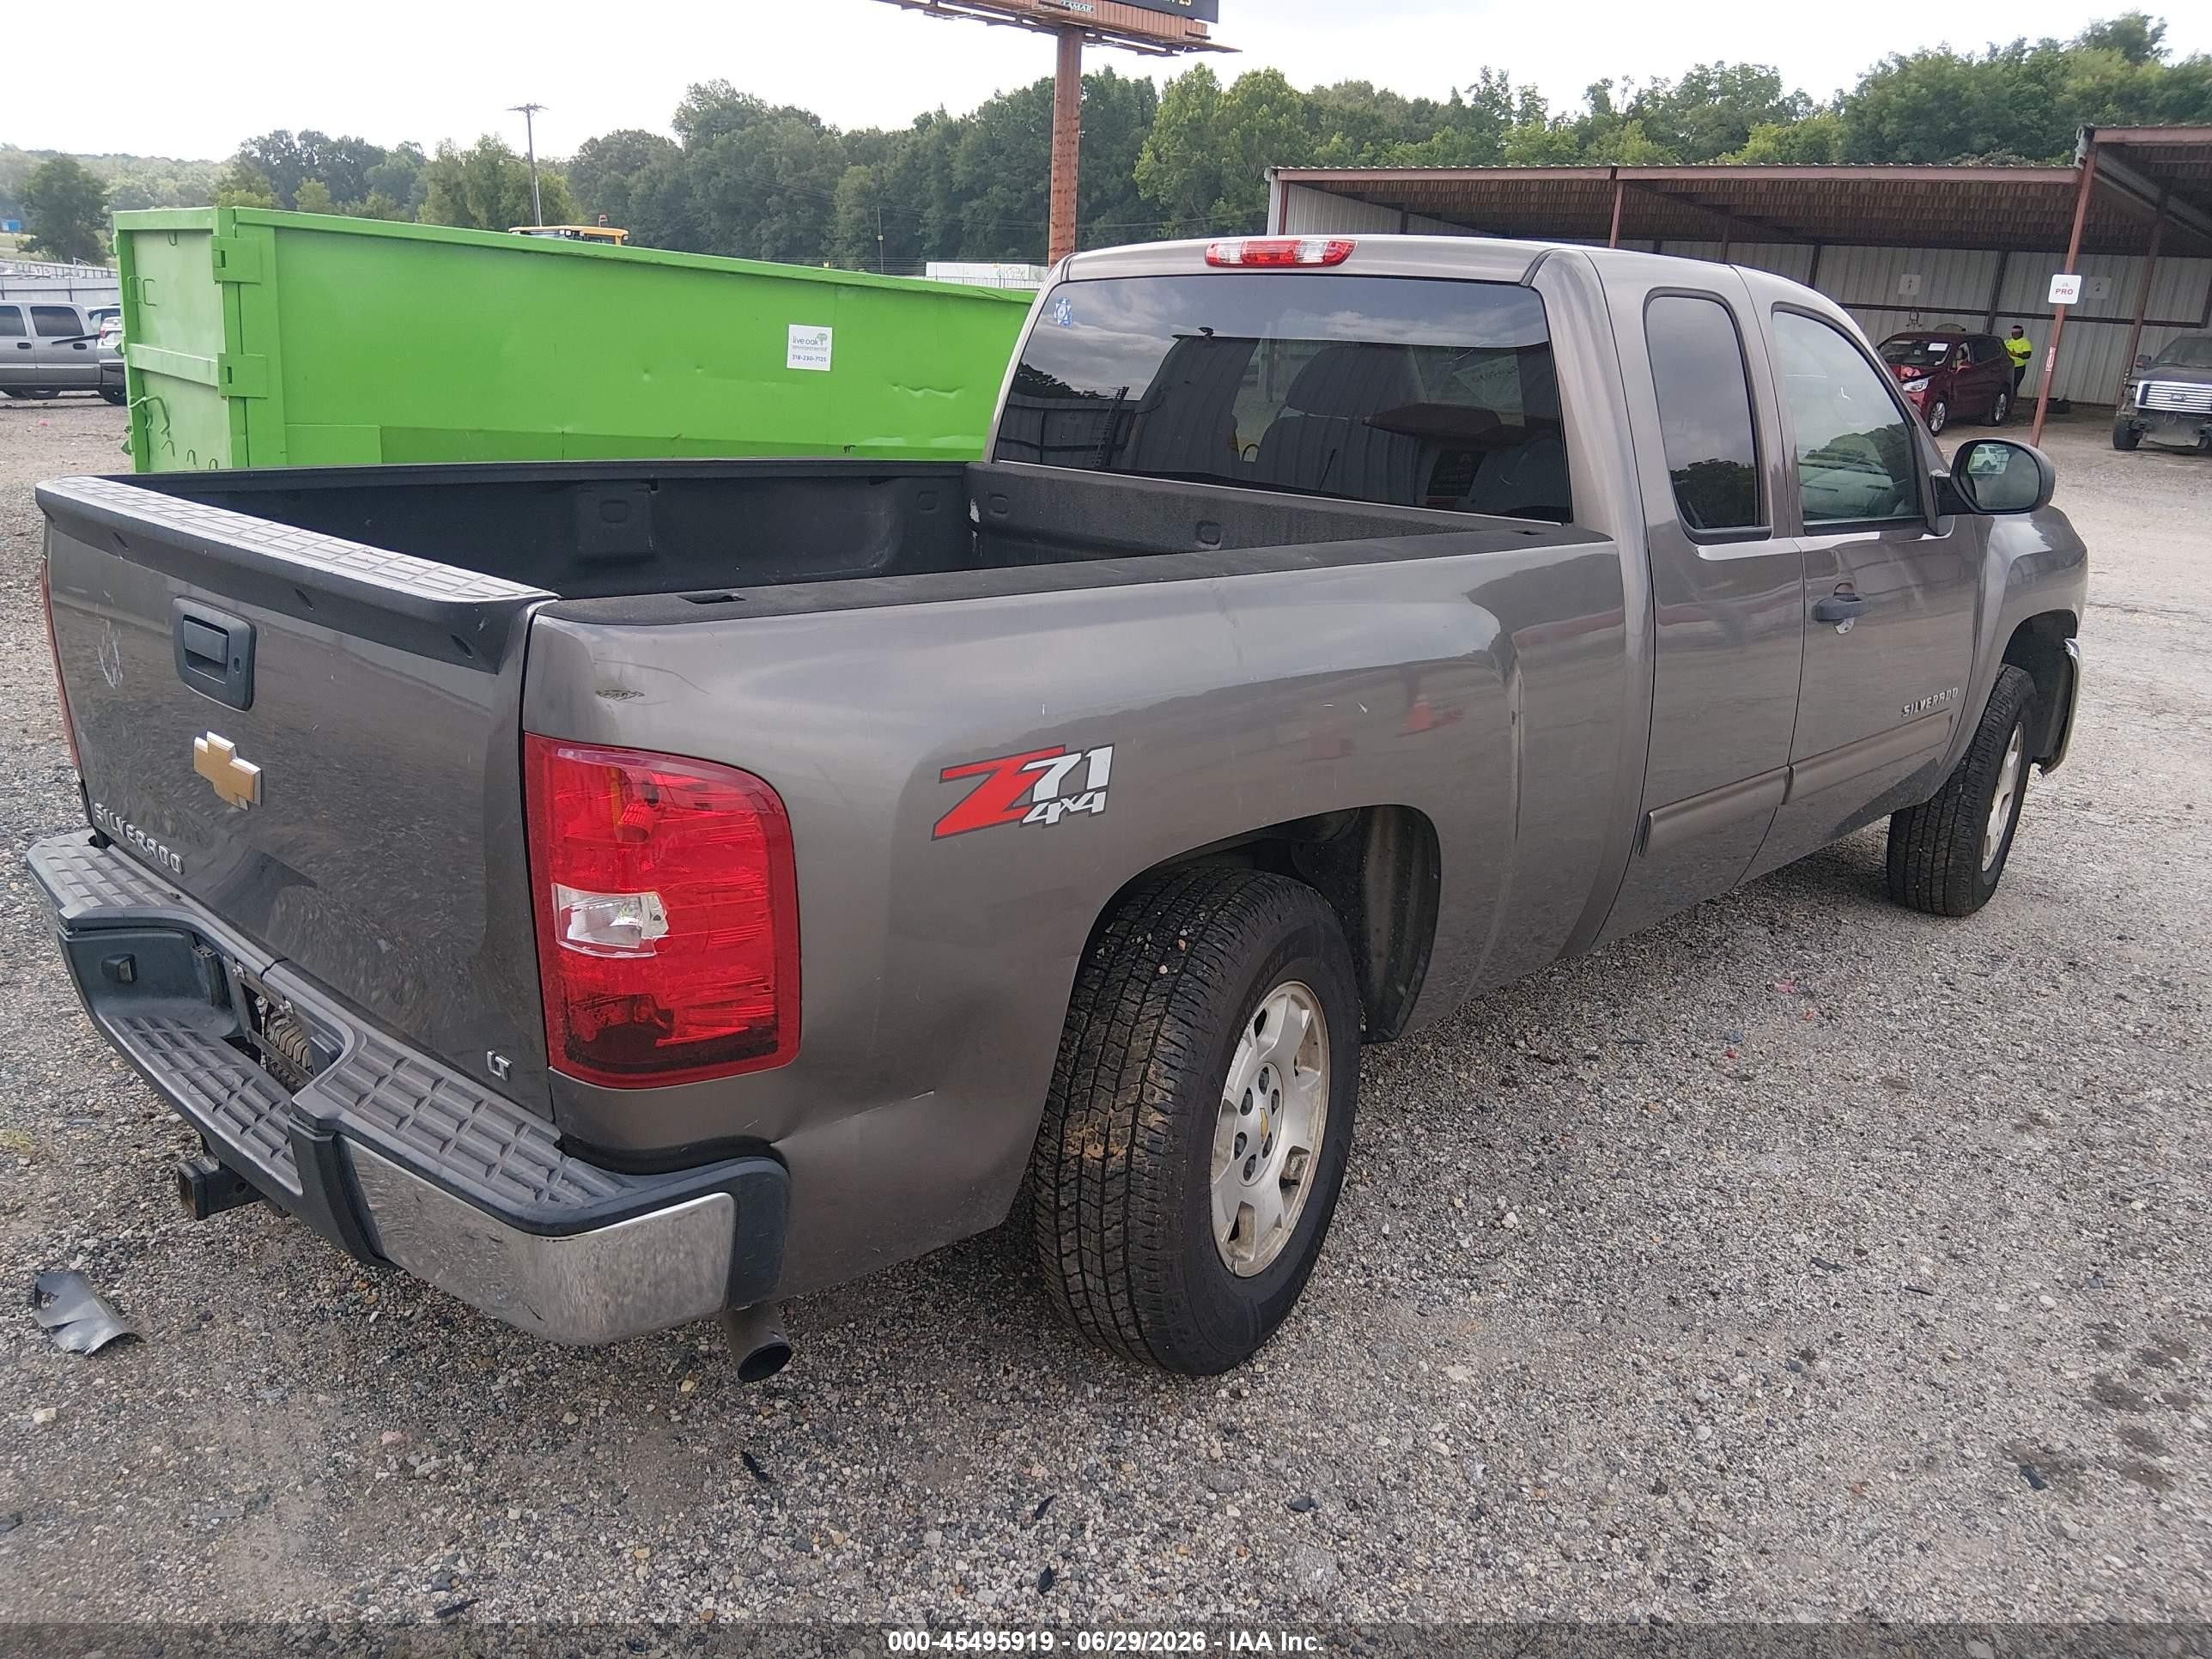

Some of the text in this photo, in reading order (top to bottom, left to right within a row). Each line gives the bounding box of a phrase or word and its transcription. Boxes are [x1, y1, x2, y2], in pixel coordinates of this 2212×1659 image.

[793, 336, 819, 346] live oak
[1901, 687, 1959, 717] SILVERADO
[932, 744, 1115, 841] Z71
[94, 802, 185, 874] SILVERADO
[486, 1049, 513, 1082] LT
